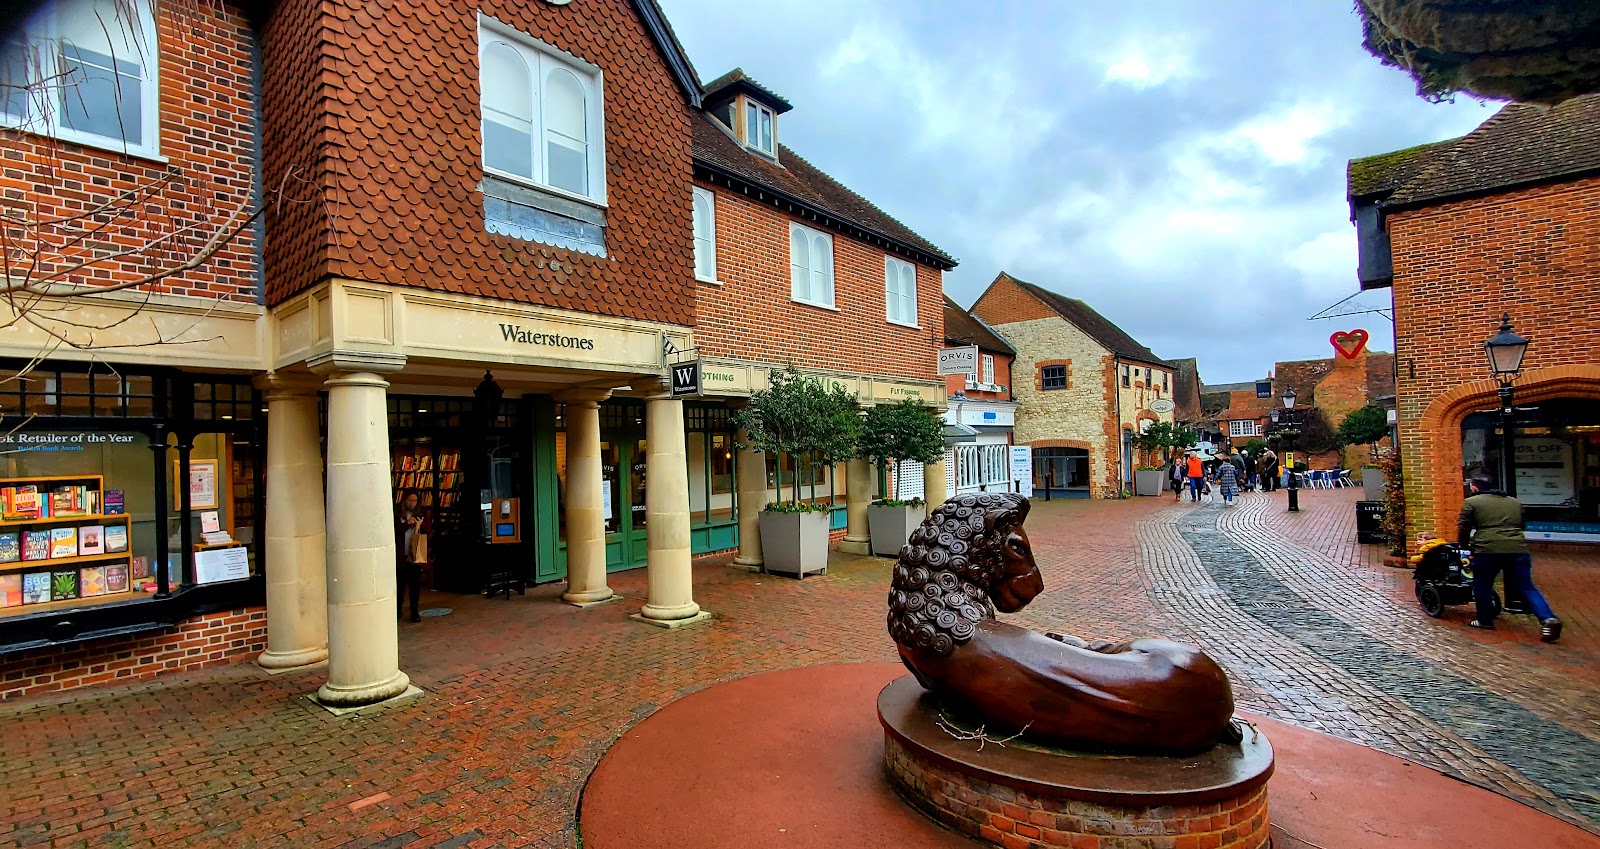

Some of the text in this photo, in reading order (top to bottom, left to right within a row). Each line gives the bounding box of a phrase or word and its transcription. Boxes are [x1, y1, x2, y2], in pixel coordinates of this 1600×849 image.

[499, 323, 594, 350] Waterstones
[940, 352, 973, 362] ORVIS
[675, 367, 694, 386] W
[18, 433, 67, 443] Retailer
[70, 433, 85, 443] of
[87, 434, 106, 443] the
[108, 434, 134, 443] Year
[1537, 444, 1563, 453] OFF
[25, 576, 50, 586] BBC
